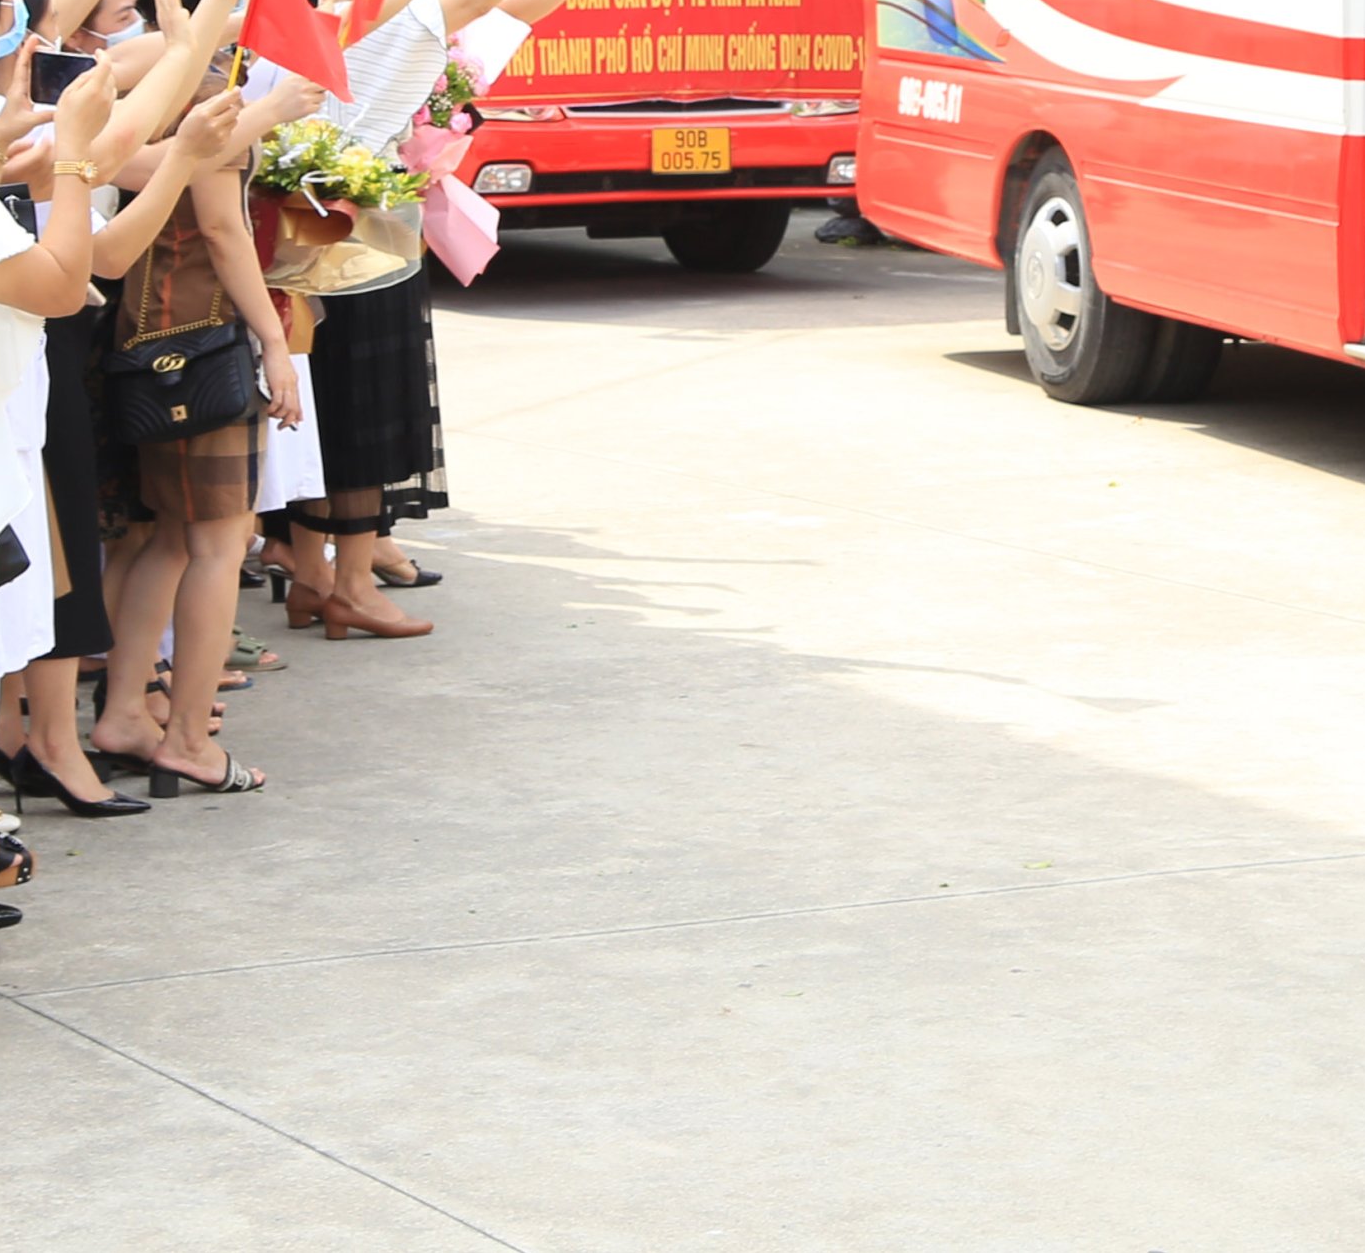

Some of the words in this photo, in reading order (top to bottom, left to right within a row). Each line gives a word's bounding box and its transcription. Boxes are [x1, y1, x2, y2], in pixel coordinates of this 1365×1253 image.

[538, 30, 592, 75] THÀNH
[595, 23, 627, 74] PHỐ
[631, 23, 653, 74] HỒ
[657, 27, 683, 72] CHÍ
[685, 34, 725, 71] MINH
[727, 21, 776, 71] CHỐNG
[779, 33, 811, 79] DỊCH
[674, 130, 708, 148] 90B
[661, 151, 721, 170] 005.75
